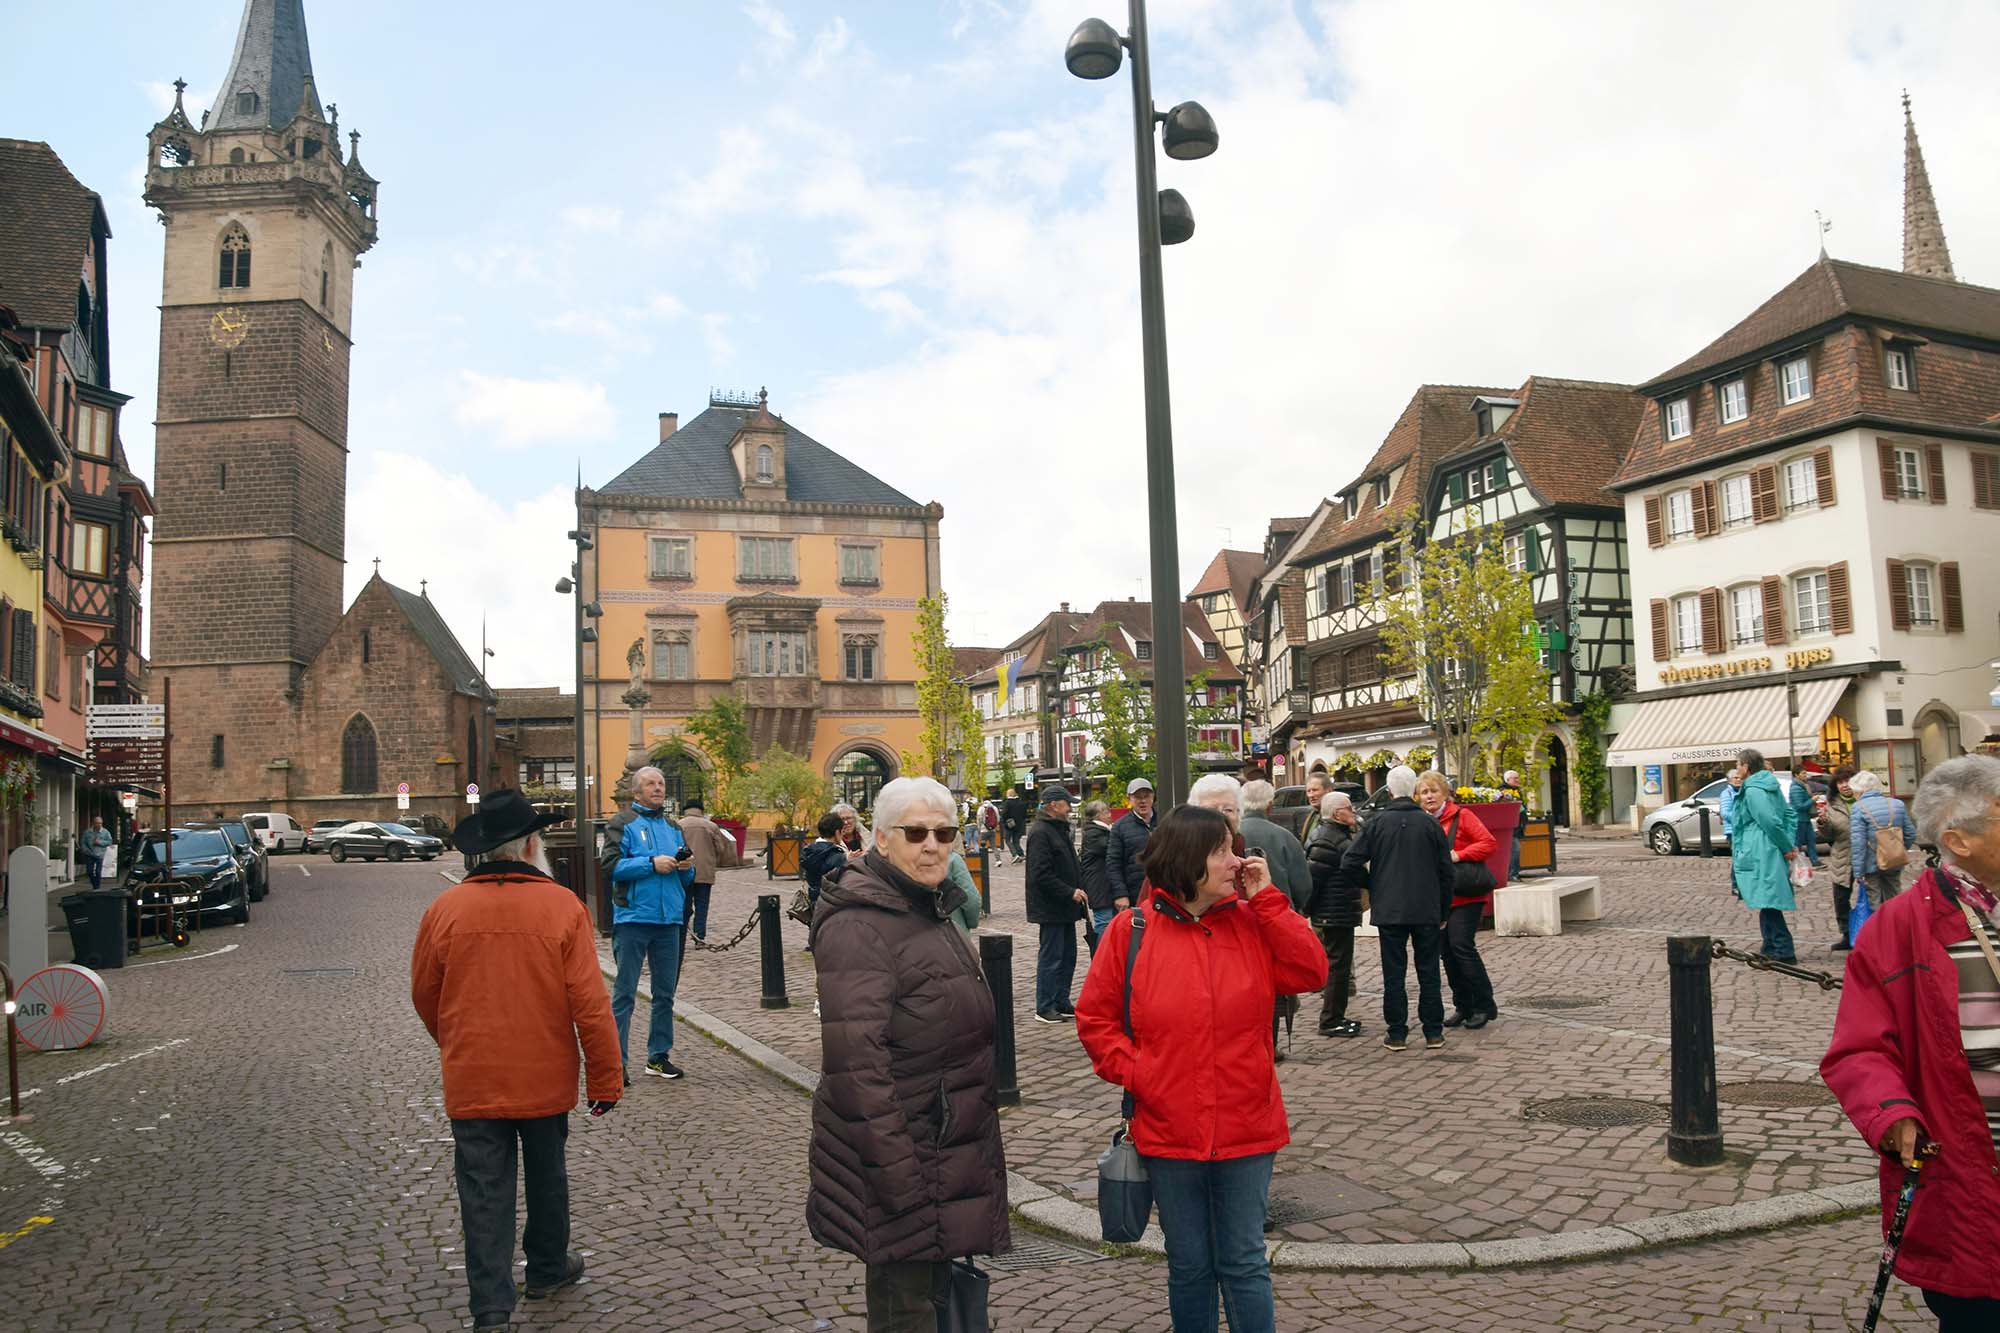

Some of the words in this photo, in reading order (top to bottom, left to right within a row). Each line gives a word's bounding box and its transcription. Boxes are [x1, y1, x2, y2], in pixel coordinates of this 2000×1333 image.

[1567, 556, 1582, 703] PHARMACIE
[1658, 656, 1771, 682] chaussures
[1785, 647, 1832, 669] gyss
[1671, 749, 1722, 760] CHAUSSURES
[17, 1003, 47, 1017] AIR
